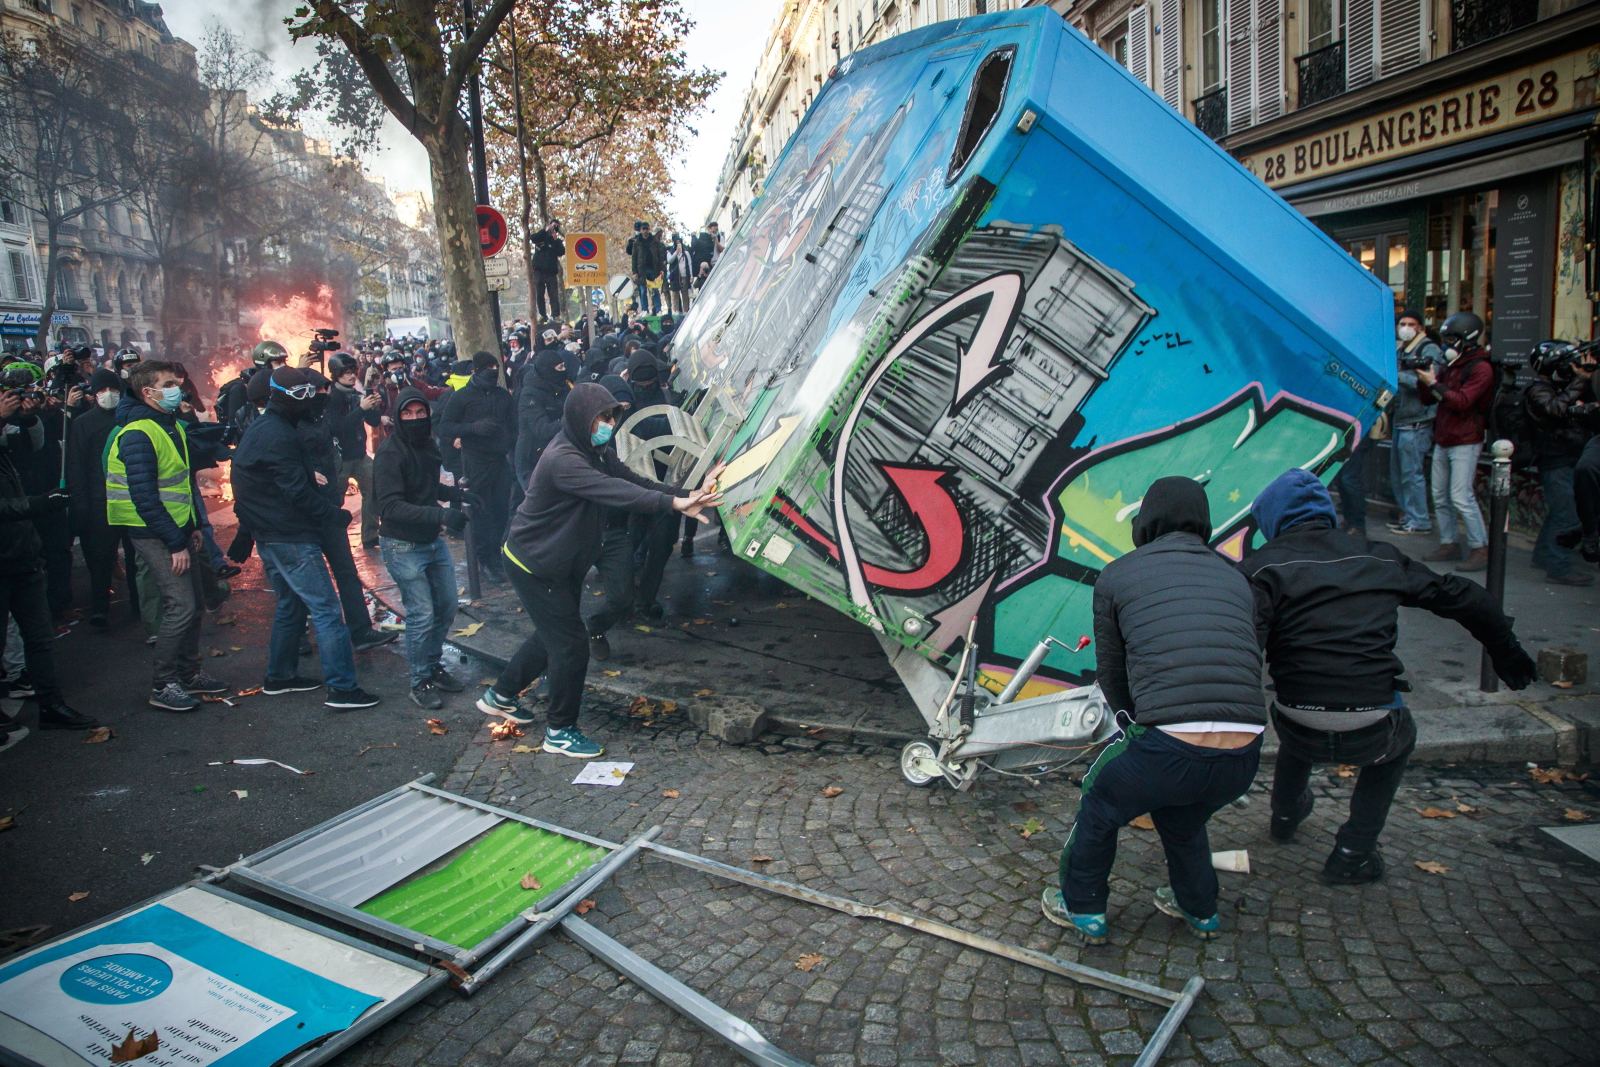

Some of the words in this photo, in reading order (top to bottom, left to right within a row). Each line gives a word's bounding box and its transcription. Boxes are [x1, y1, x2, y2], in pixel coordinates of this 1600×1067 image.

[1264, 153, 1286, 182] 28
[1294, 84, 1500, 175] BOULANGERIE
[1515, 70, 1559, 116] 28
[1325, 195, 1357, 210] MAISON
[1360, 182, 1420, 206] LANDEMAINE
[75, 976, 102, 988] MET
[77, 964, 136, 990] POLLUEURS
[206, 976, 228, 990] Paris
[98, 984, 131, 1000] PARIS
[132, 985, 155, 996] LES
[257, 1002, 273, 1011] 100
[78, 1014, 122, 1042] détritus
[164, 1026, 200, 1043] peine
[187, 1018, 239, 1044] d'amende
[168, 1046, 183, 1057] le
[194, 1040, 222, 1053] sous
[181, 1054, 204, 1064] sur
